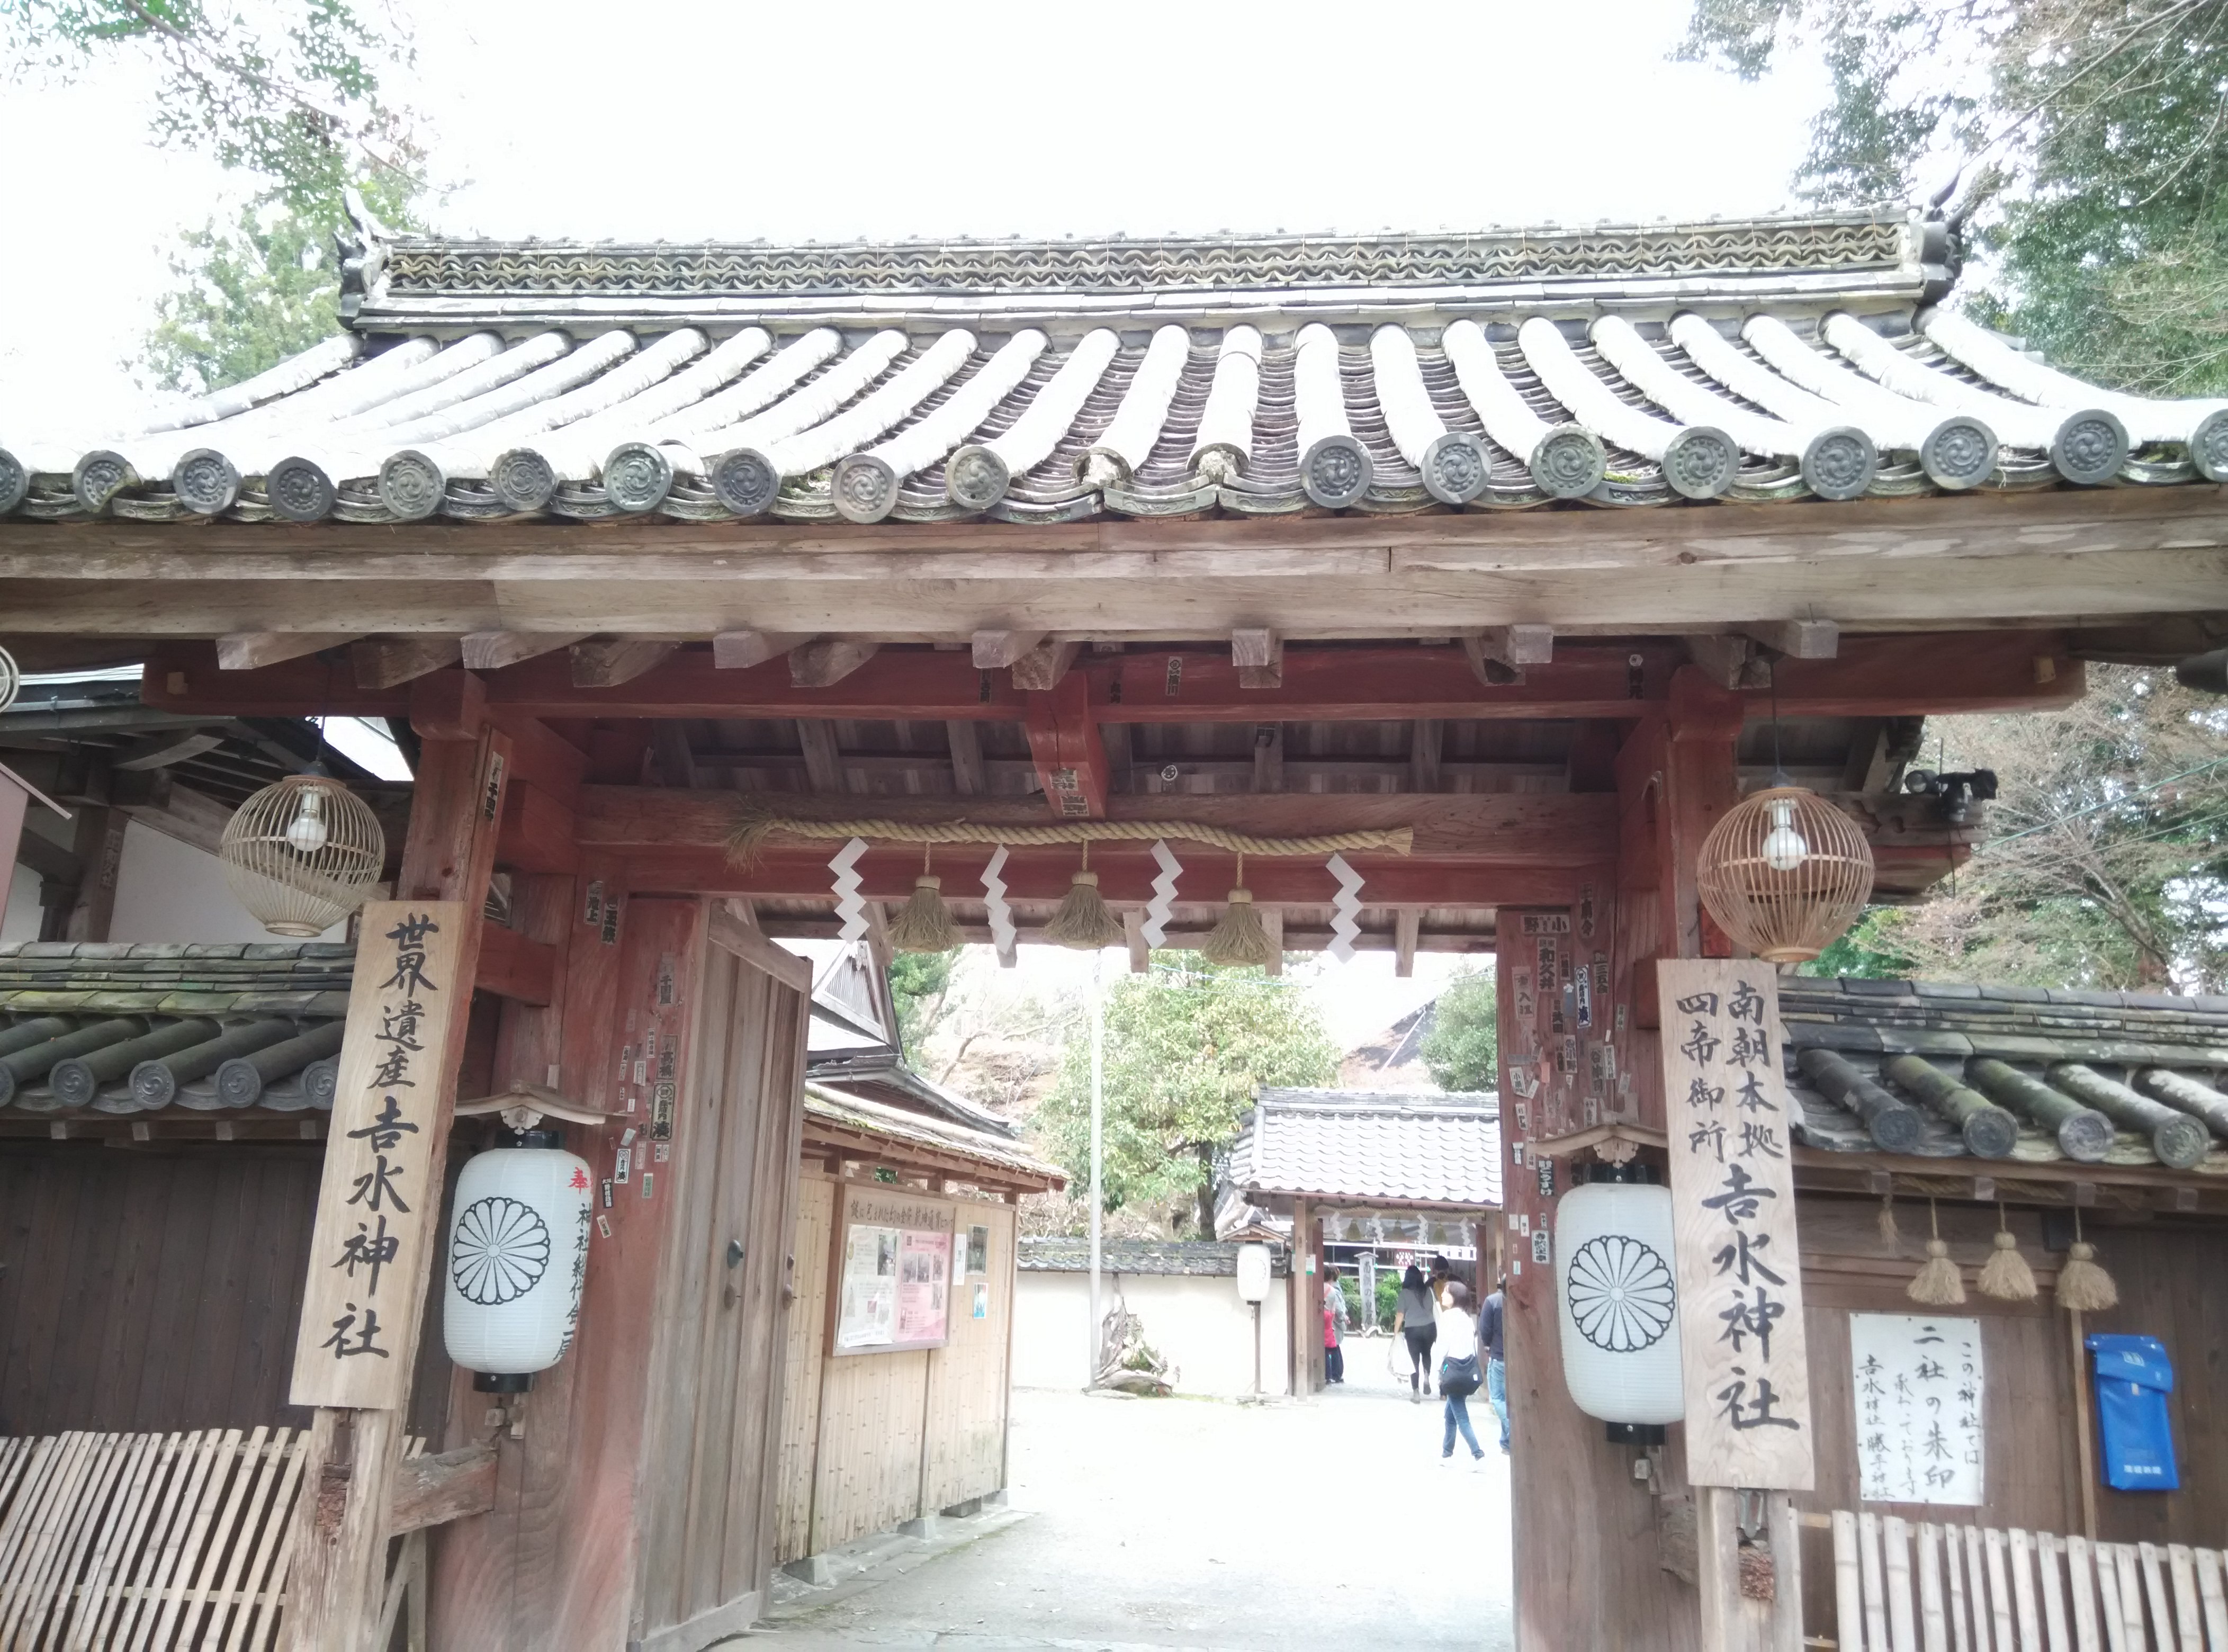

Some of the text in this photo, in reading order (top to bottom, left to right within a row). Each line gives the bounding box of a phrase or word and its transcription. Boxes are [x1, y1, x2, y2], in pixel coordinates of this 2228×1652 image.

[1676, 992, 1727, 1164] 四帝御所
[1726, 980, 1784, 1159] 南朝本拠
[1701, 1163, 1800, 1430] 吉水神社
[1913, 1325, 1955, 1488] 二社の朱印
[1957, 1342, 1981, 1465] この神社では
